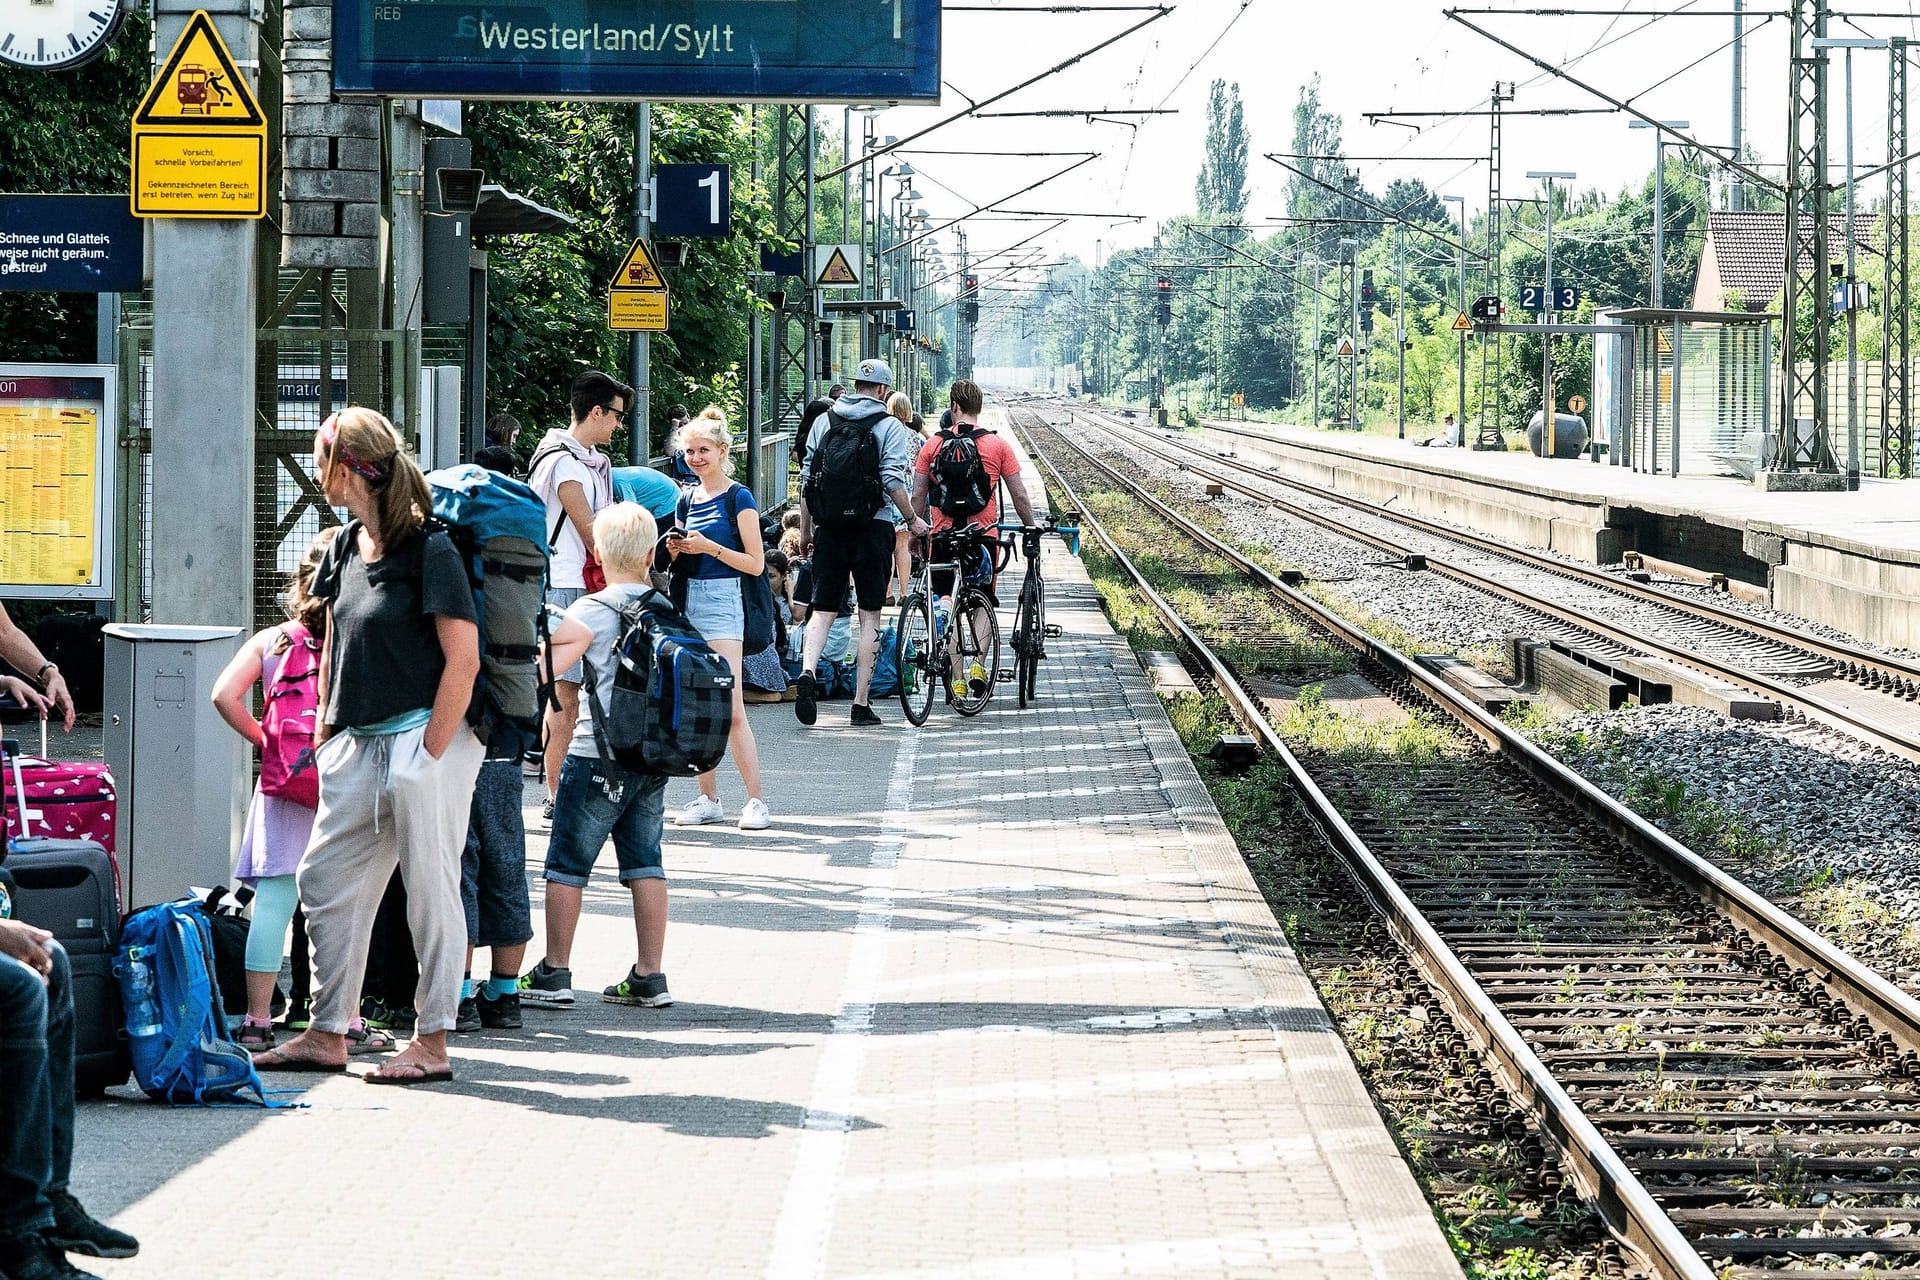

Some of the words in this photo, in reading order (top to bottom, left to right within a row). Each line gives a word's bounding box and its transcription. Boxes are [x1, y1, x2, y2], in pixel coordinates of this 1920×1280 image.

[375, 6, 401, 20] RE6
[479, 22, 735, 59] Westerland/Sylt
[183, 148, 215, 157] Vorsicht,
[154, 158, 187, 167] schnelle
[189, 158, 243, 167] Vorbeifahrten!
[147, 180, 217, 189] Gekennzeichneten
[219, 181, 250, 190] Bereich
[142, 191, 158, 199] erst
[160, 191, 195, 200] betreten,
[221, 191, 236, 201] Zug
[698, 170, 720, 224] 1
[42, 232, 64, 245] und
[66, 232, 110, 245] Glatteis
[31, 247, 60, 259] nicht
[1, 262, 48, 275] gestreut
[1522, 288, 1536, 307] 2
[1562, 288, 1575, 308] 3
[906, 311, 914, 328] 1
